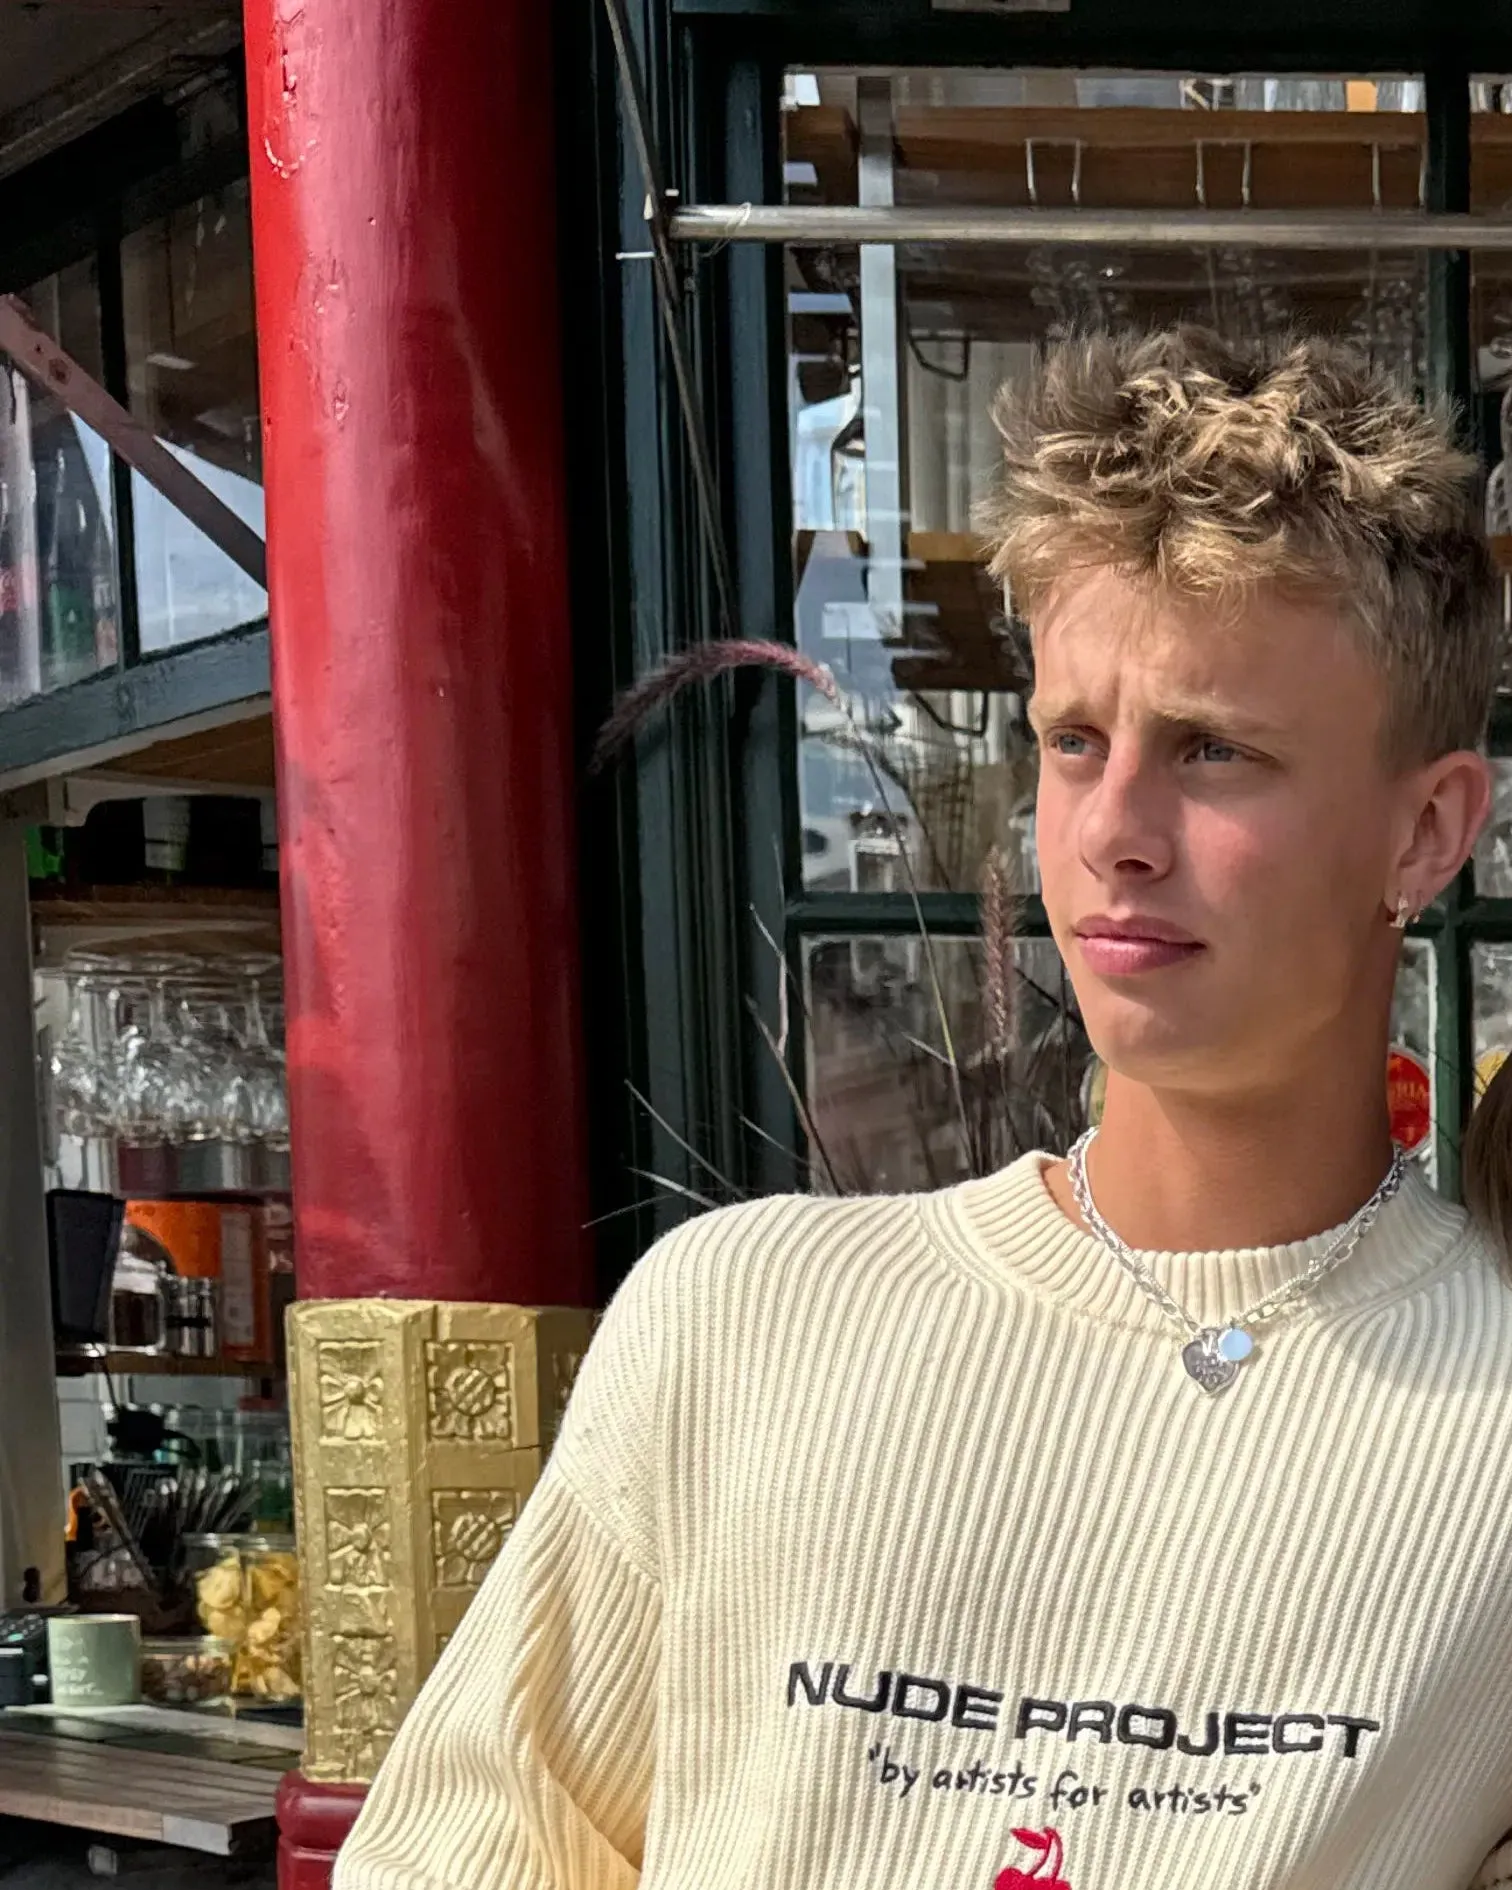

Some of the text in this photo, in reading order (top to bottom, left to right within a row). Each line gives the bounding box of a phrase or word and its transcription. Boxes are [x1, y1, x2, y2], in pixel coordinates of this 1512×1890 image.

[788, 1661, 1381, 1758] NUDE PROJECT
[931, 1760, 1038, 1799] artists
[1049, 1770, 1106, 1812] for
